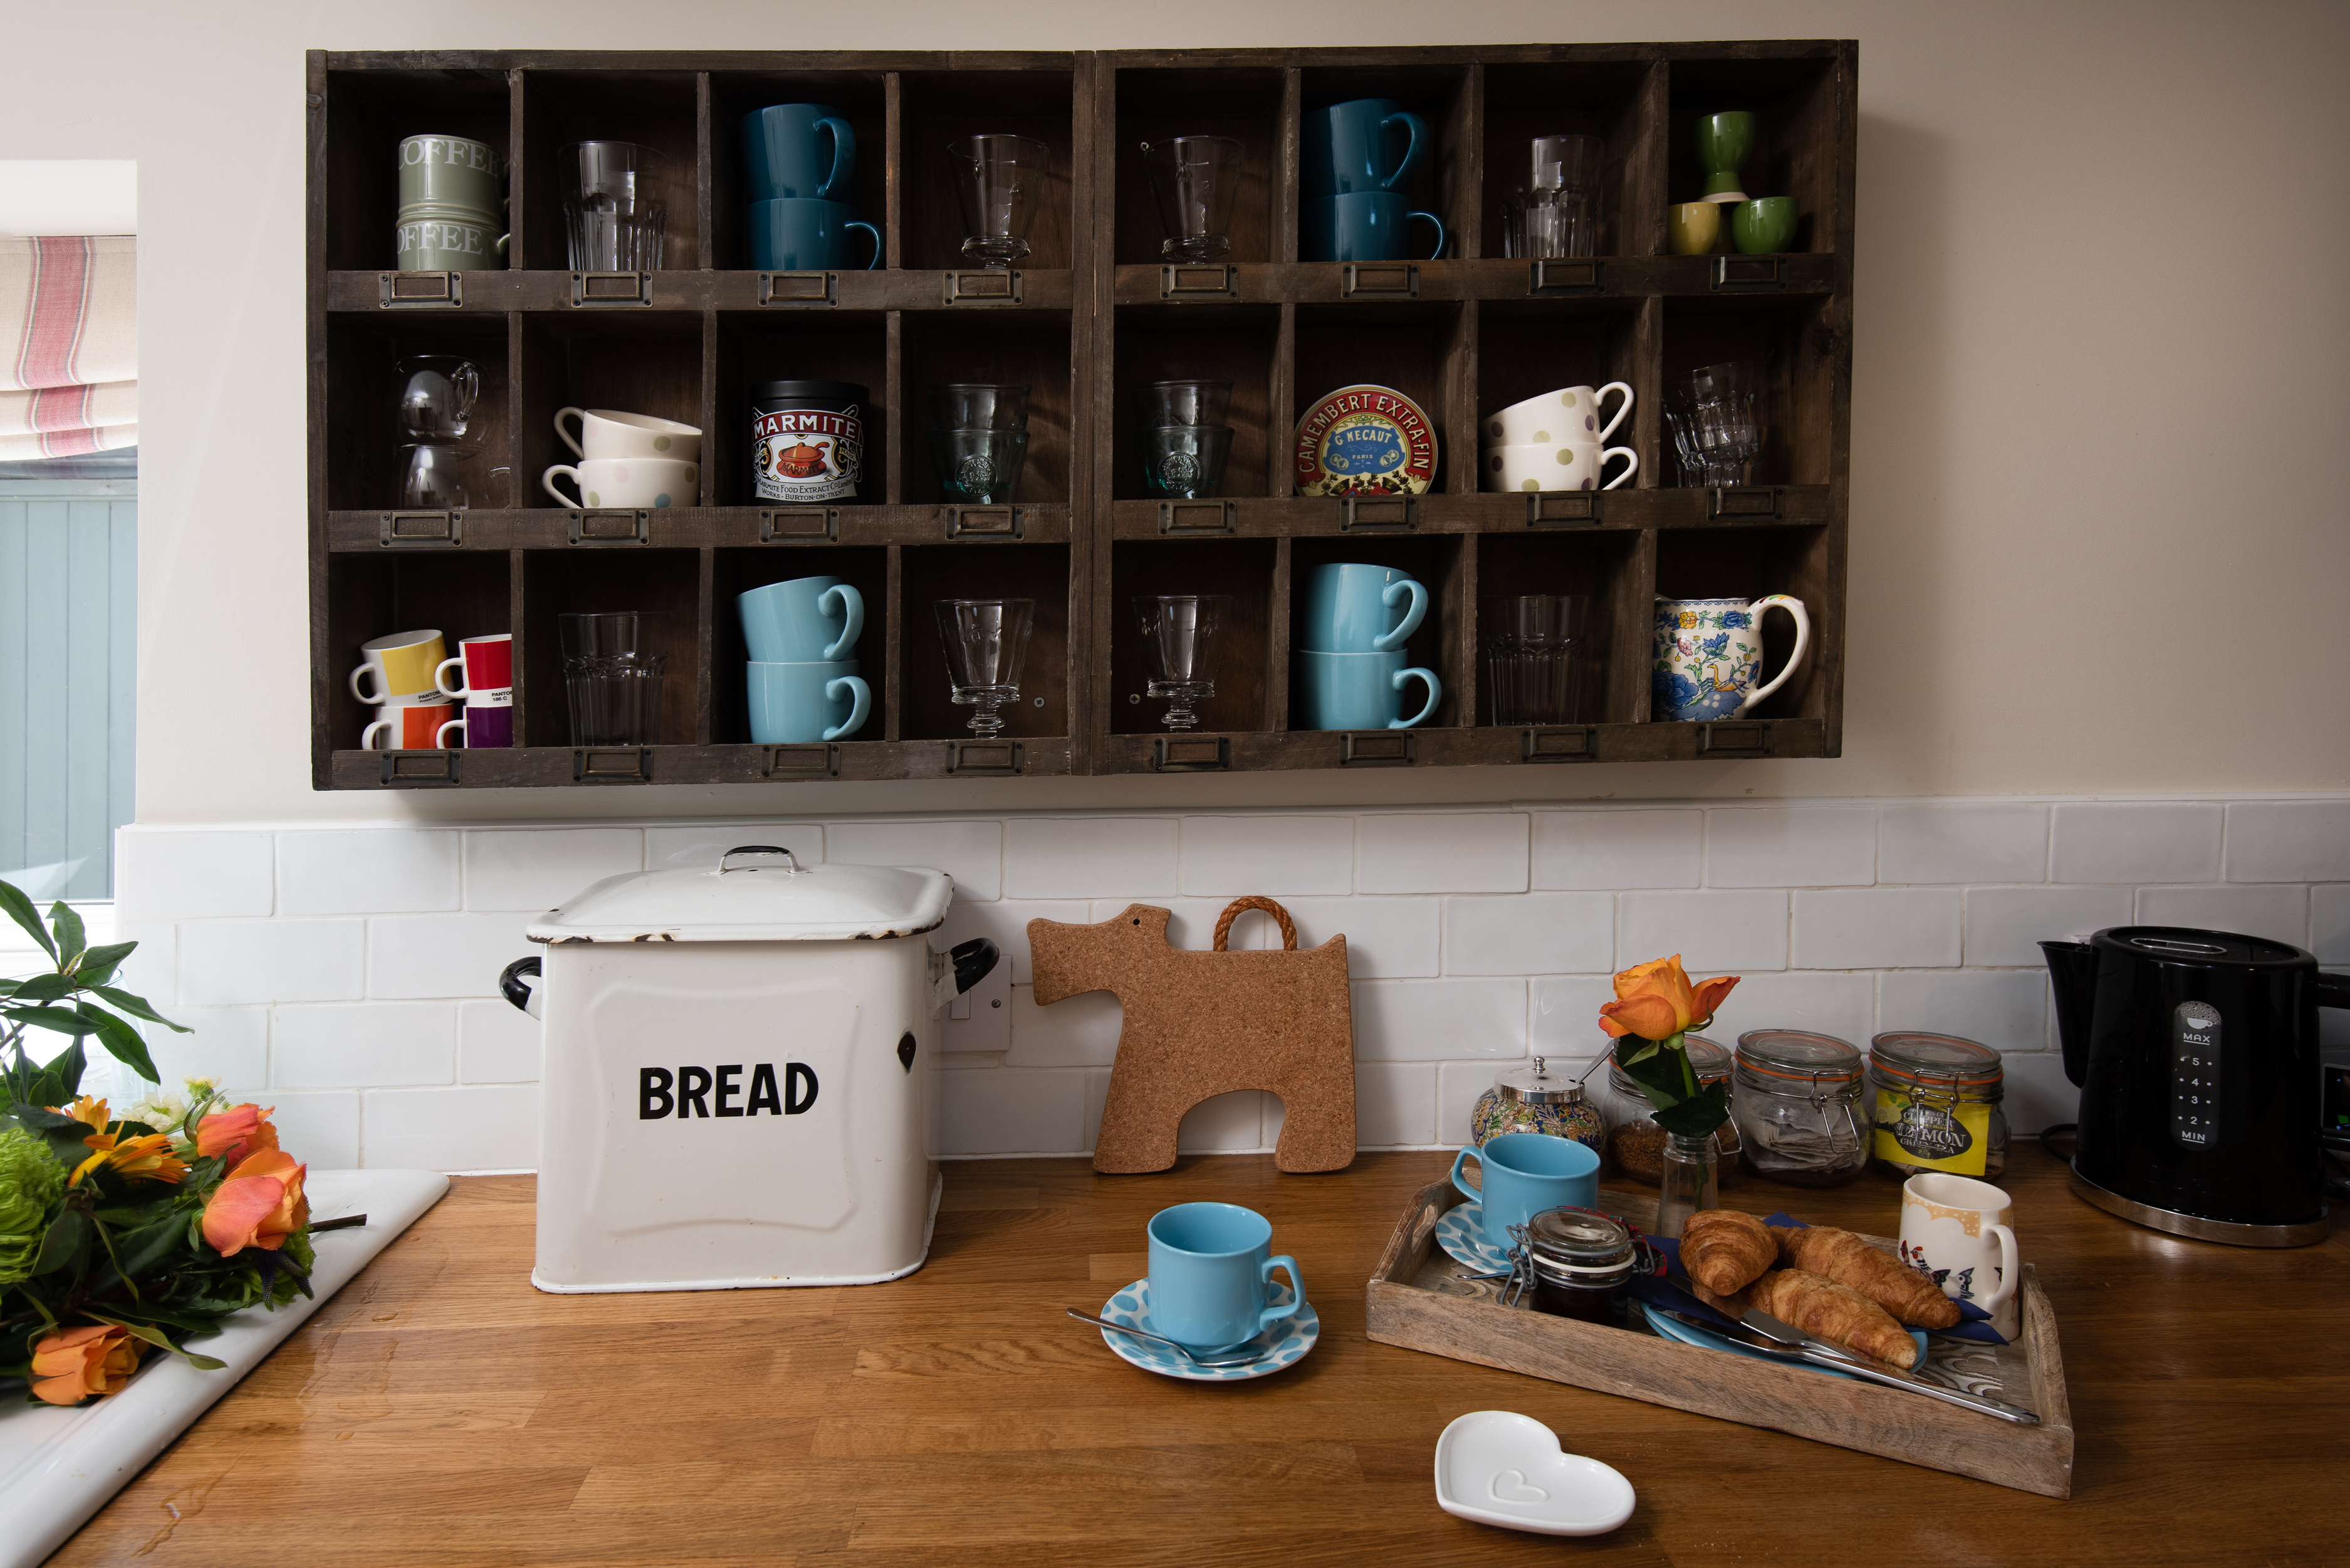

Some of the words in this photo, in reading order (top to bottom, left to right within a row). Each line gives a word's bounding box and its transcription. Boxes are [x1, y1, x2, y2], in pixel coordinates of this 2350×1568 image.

[397, 224, 483, 255] OFFEE
[754, 414, 857, 440] MARMITE
[1298, 394, 1372, 473] CAMEMBERT
[1346, 429, 1392, 443] MECAUT
[755, 449, 766, 461] TRADE
[840, 448, 855, 460] MARK
[779, 461, 822, 476] MARMITE
[757, 476, 780, 492] MARMITE
[780, 484, 798, 493] FOOD
[799, 485, 830, 494] EXTRACT
[418, 691, 441, 700] PANTON
[2183, 1032, 2210, 1043] MAX
[2192, 1057, 2200, 1066] 5
[2191, 1078, 2199, 1086] 4
[639, 1062, 819, 1120] BREAD
[2191, 1095, 2198, 1104] 3
[2190, 1116, 2198, 1125] 2
[2181, 1130, 2205, 1141] MIN
